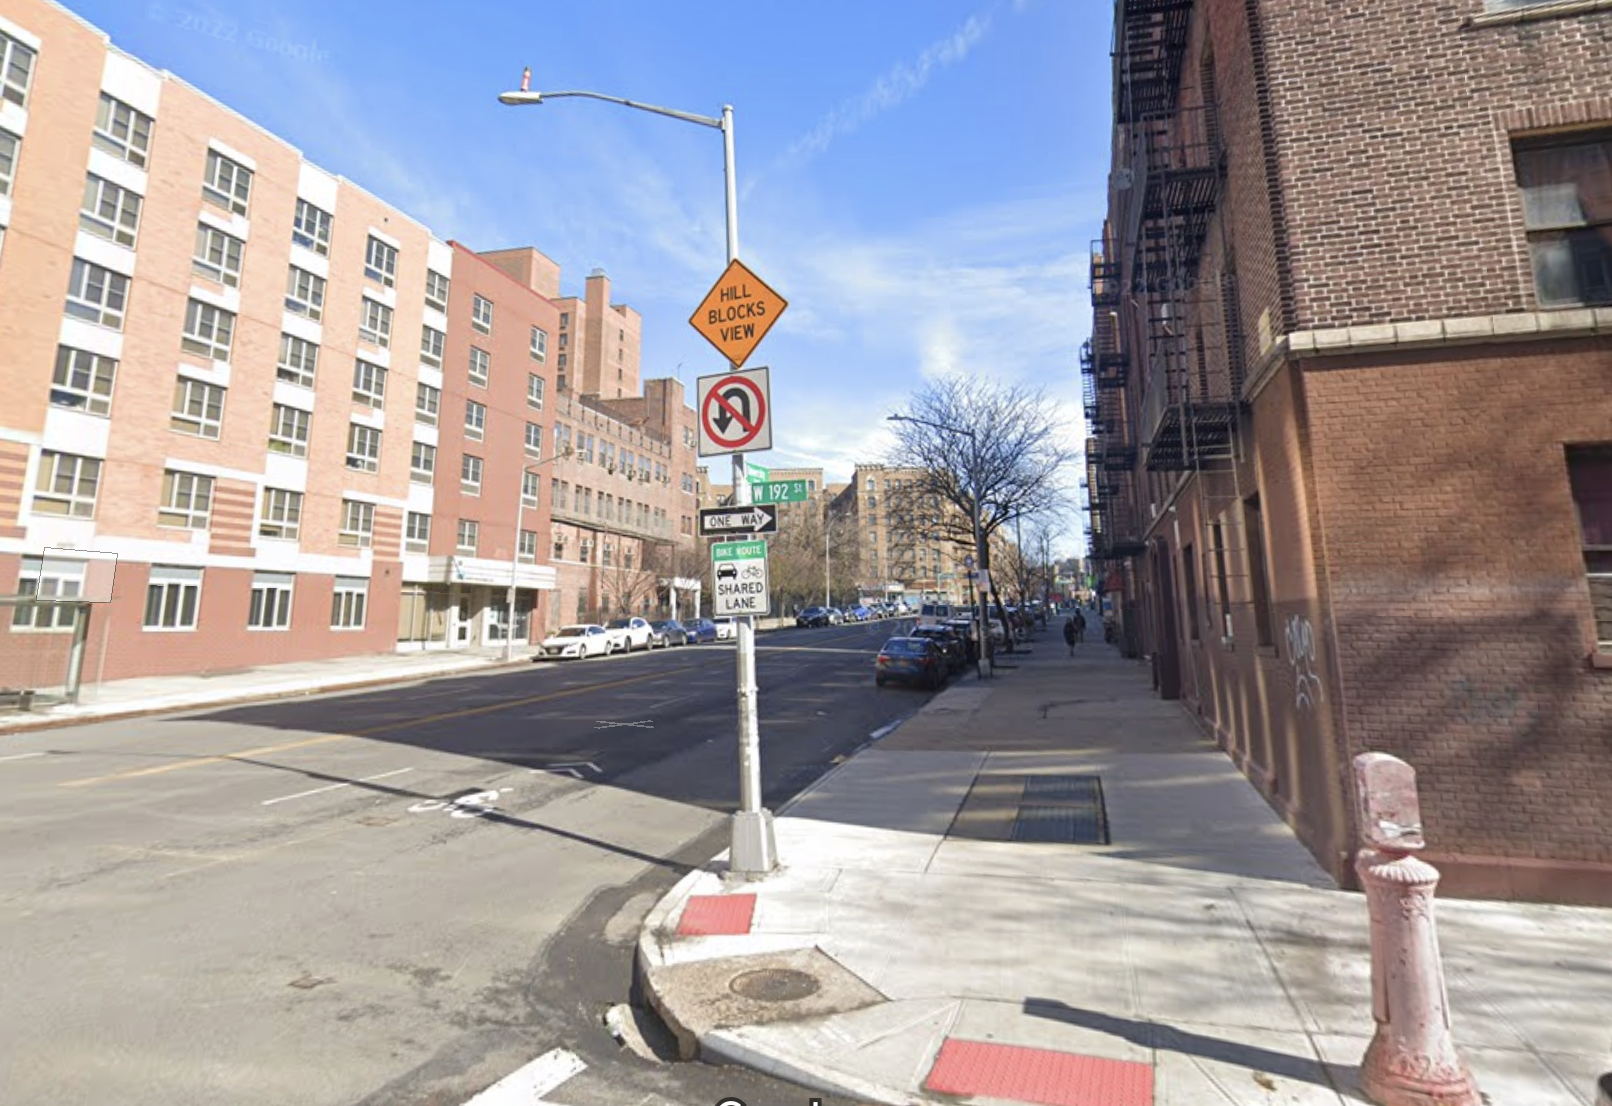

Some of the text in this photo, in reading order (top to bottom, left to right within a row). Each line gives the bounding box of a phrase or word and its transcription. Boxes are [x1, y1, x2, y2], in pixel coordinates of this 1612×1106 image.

[720, 284, 752, 302] HILL
[708, 301, 766, 324] BLOCKS
[720, 323, 755, 342] VIEW
[753, 485, 763, 501] W
[769, 483, 789, 500] 192
[709, 513, 764, 527] ONE WAY
[716, 547, 733, 557] BIKE
[718, 582, 764, 596] SHARED
[725, 597, 756, 610] LANE
